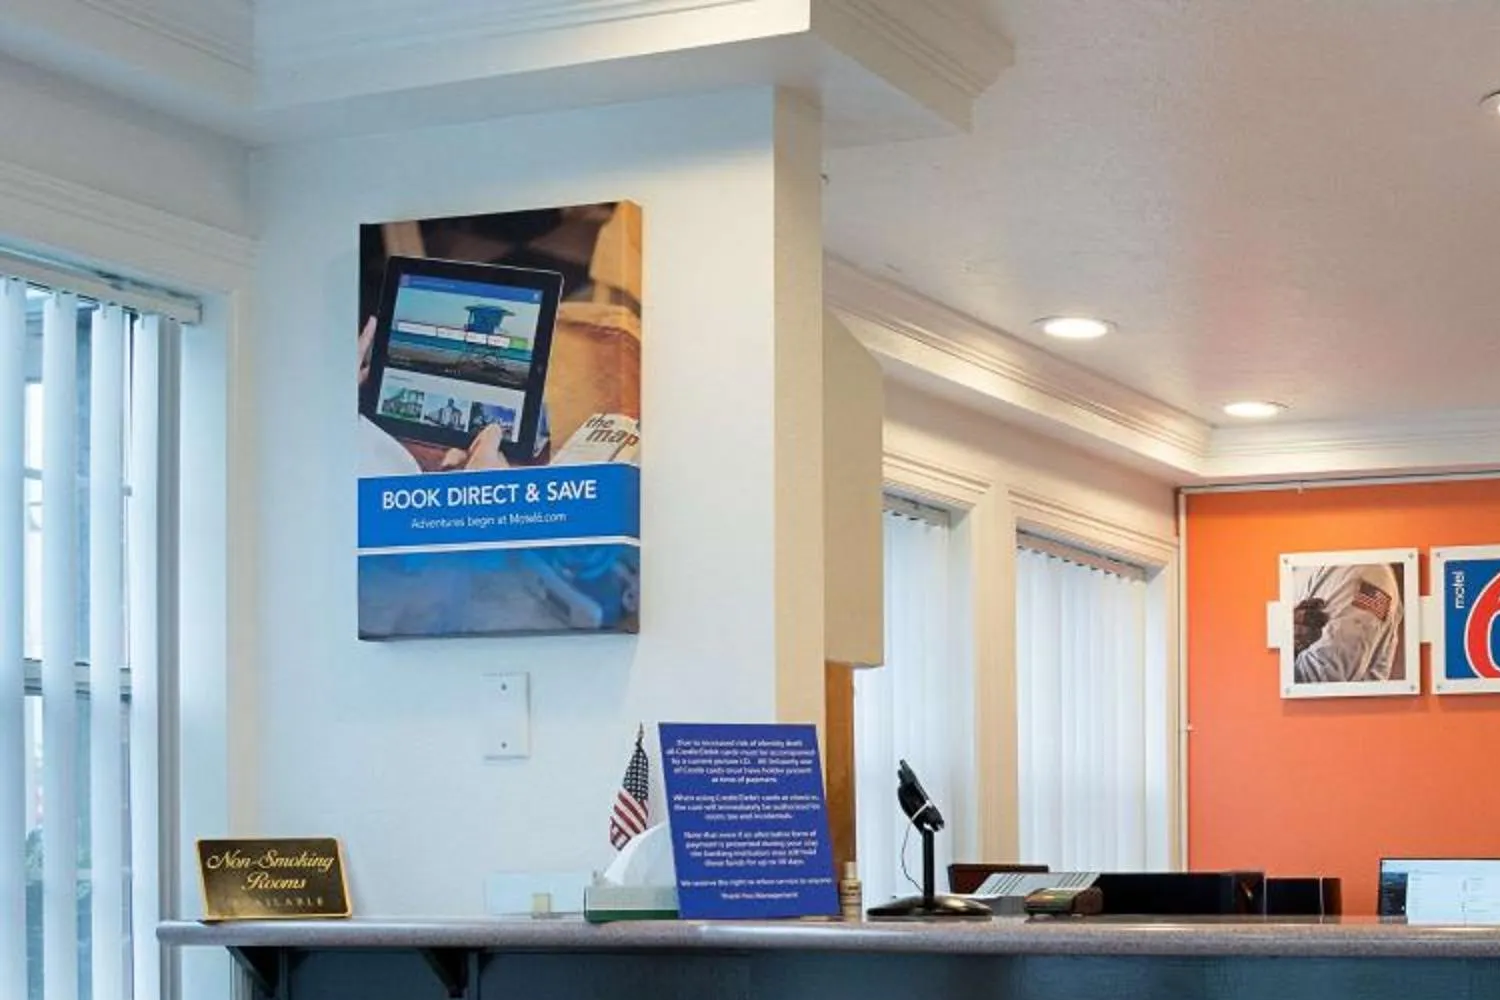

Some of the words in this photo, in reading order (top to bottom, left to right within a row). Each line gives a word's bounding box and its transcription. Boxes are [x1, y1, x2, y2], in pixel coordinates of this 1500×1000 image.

[586, 412, 615, 429] the
[585, 430, 640, 462] map
[382, 488, 441, 511] BOOK
[447, 483, 520, 508] DIRECT
[525, 482, 540, 503] &
[546, 479, 598, 502] SAVE
[411, 517, 466, 529] Adventures
[467, 514, 496, 529] begin
[497, 515, 507, 525] at
[509, 511, 567, 525] Motel6.com
[1452, 571, 1465, 609] motel
[207, 849, 335, 873] Non-Smoking
[241, 871, 308, 891] Rooms
